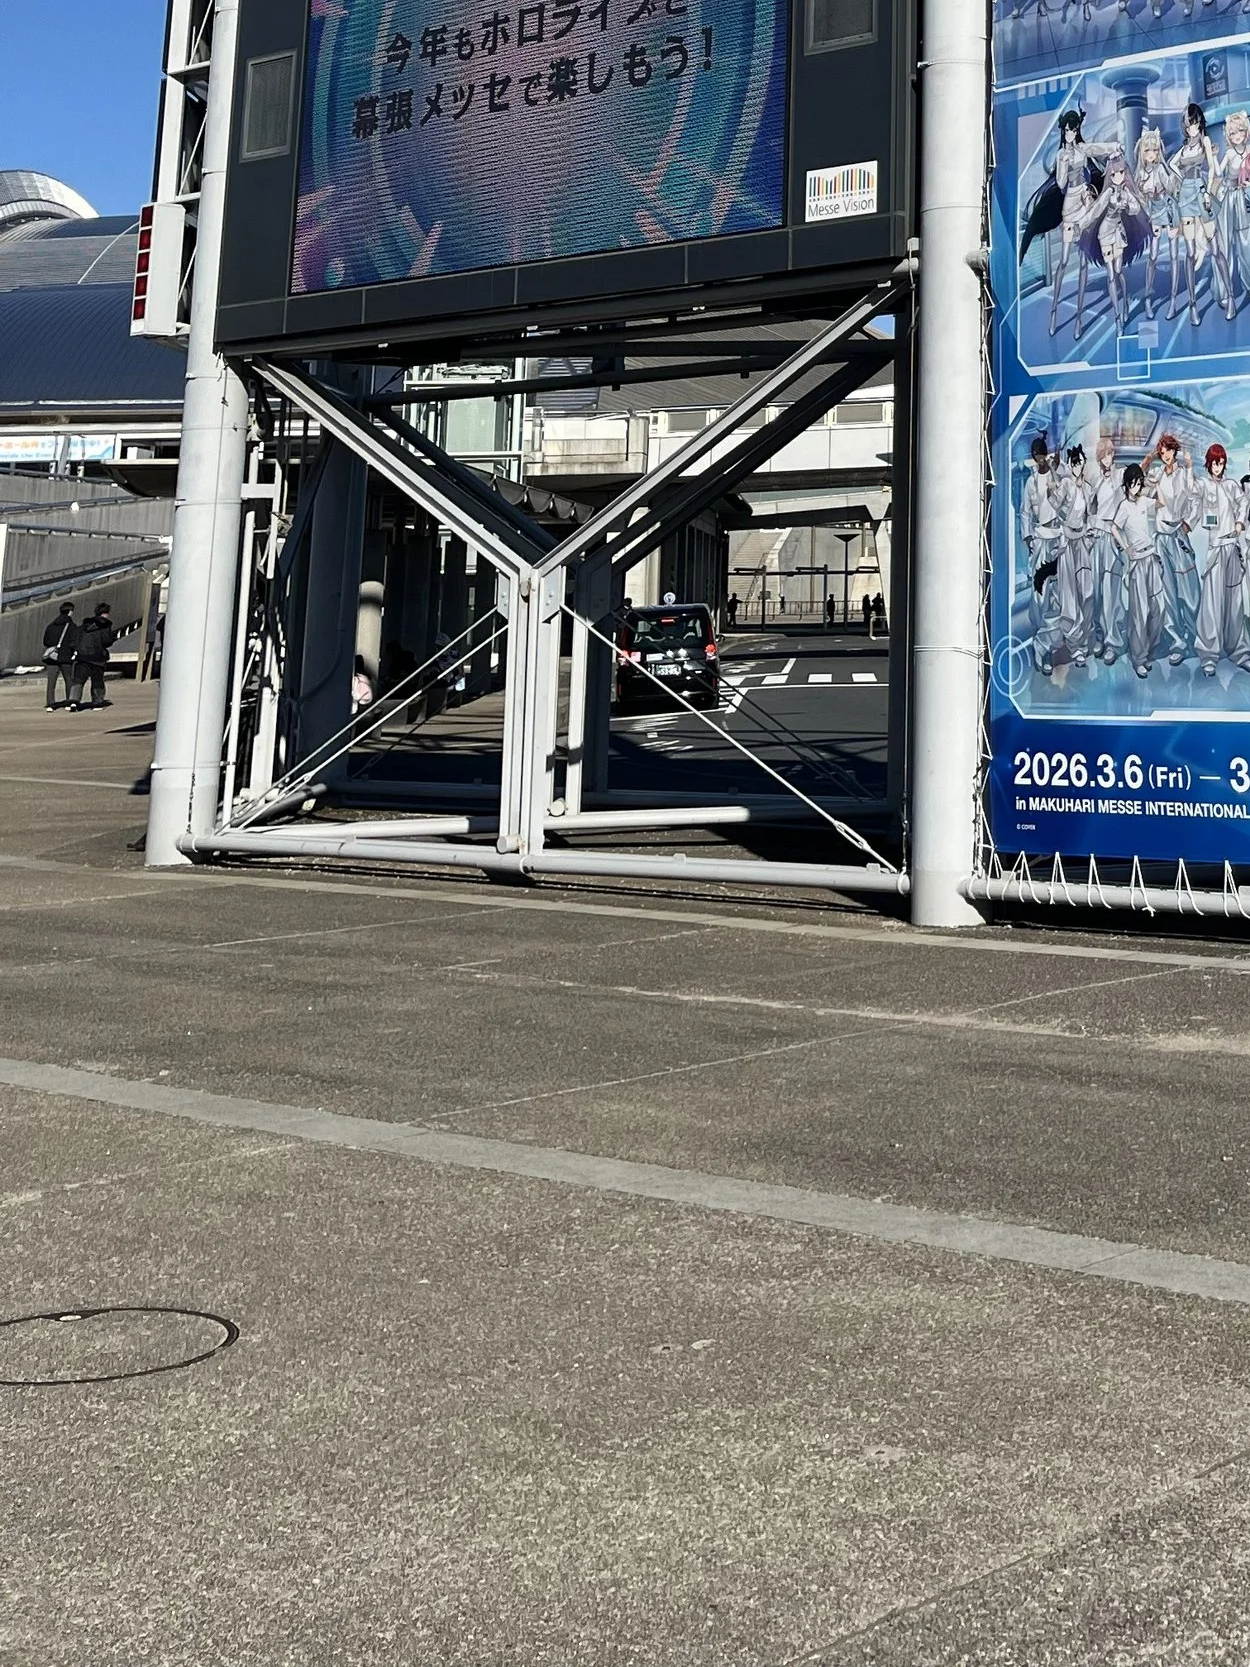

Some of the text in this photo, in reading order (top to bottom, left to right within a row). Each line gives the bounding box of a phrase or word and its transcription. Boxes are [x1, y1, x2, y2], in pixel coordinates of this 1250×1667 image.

[352, 26, 713, 139] 幕張メッセで楽しもう！
[808, 198, 874, 218] Messe Vision
[1014, 752, 1143, 789] 2026.3.6
[1148, 763, 1191, 791] (Fri)
[1016, 797, 1026, 811] in
[1029, 797, 1094, 813] MAKUHARI
[1098, 799, 1142, 815] MESSE
[1145, 801, 1250, 819] INTERNATIONAL
